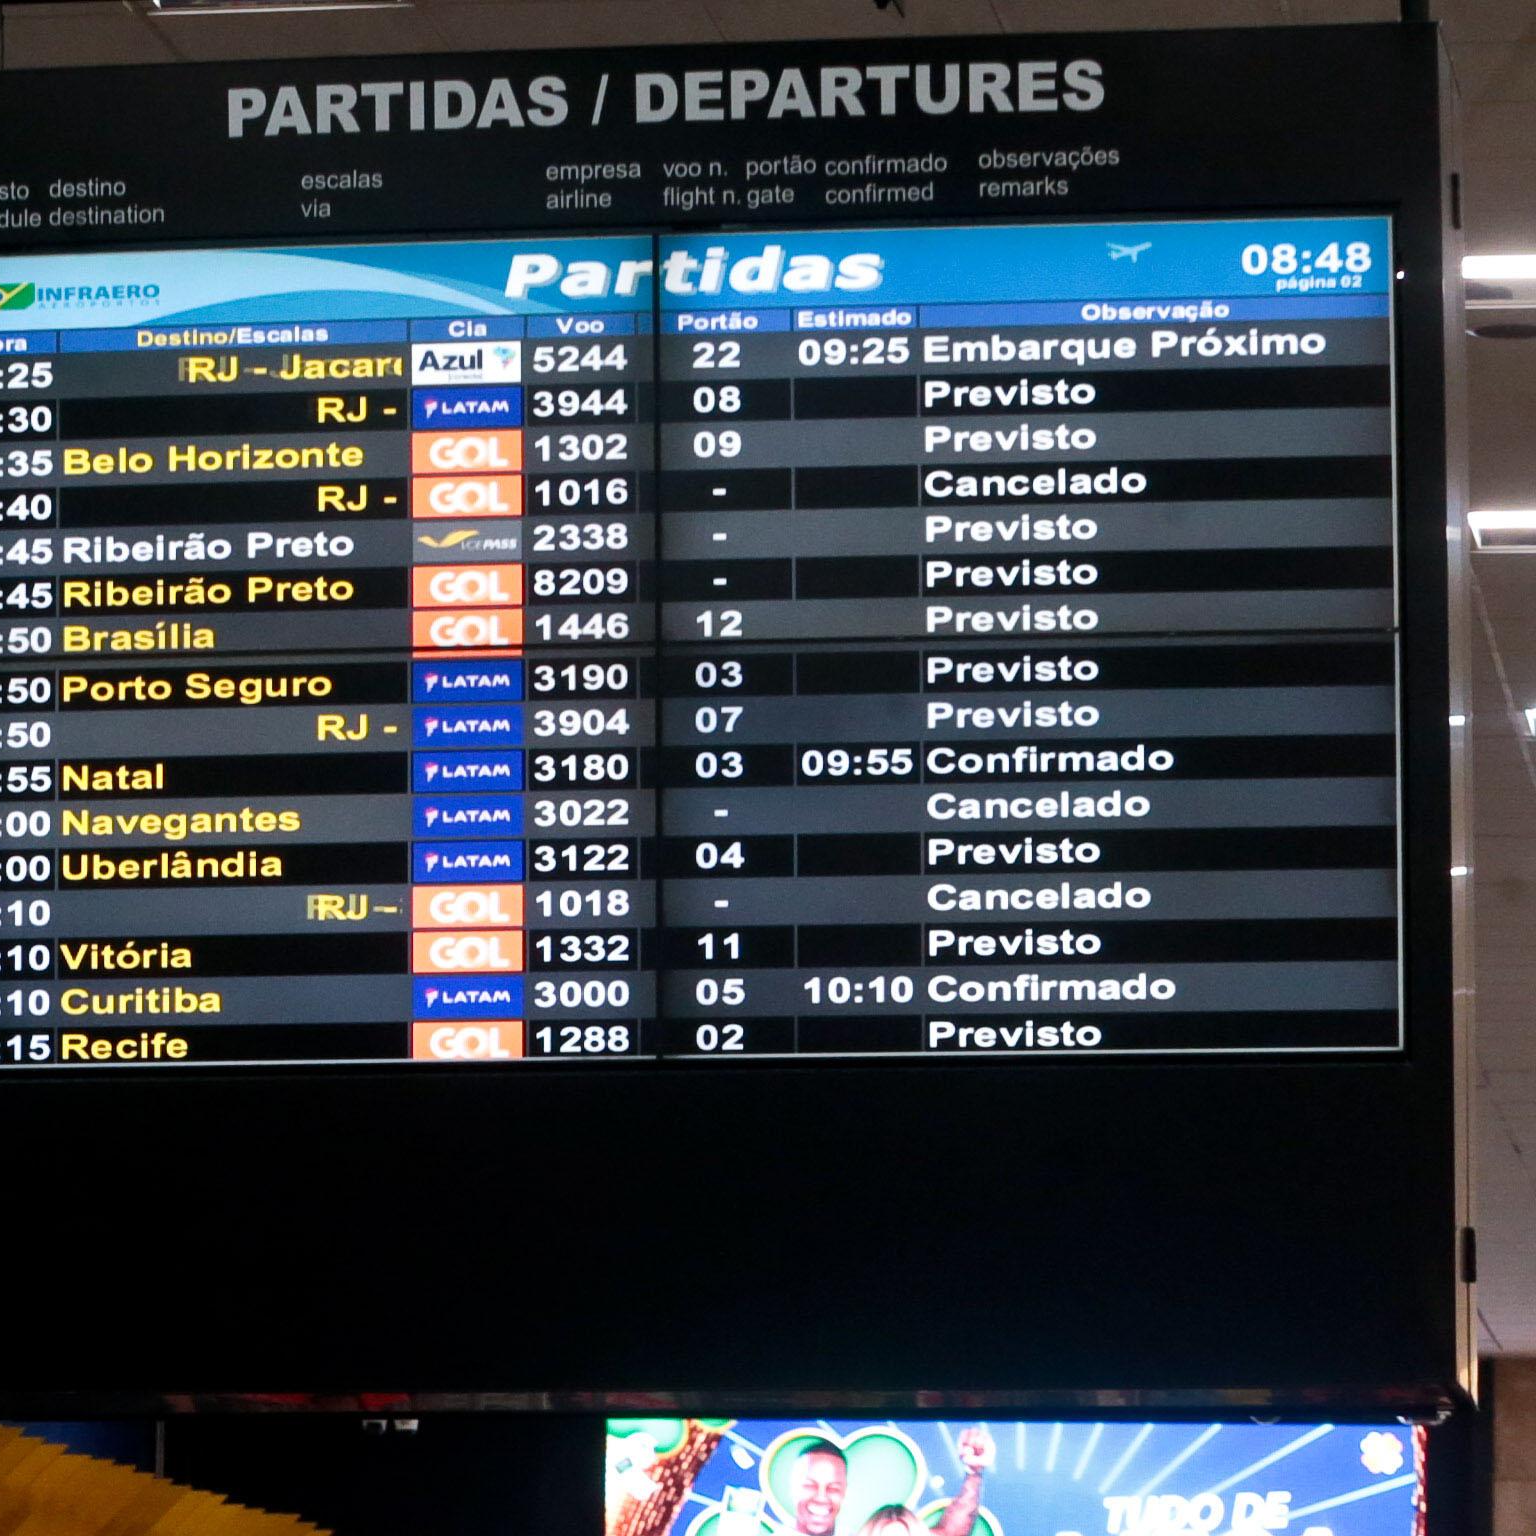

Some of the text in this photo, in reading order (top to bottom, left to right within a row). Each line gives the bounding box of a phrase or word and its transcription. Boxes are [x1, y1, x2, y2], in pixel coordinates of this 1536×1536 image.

[228, 76, 569, 138] PARTIDAS
[634, 59, 1105, 125] DEPARTURES
[545, 160, 642, 186] empresa
[663, 160, 703, 179] voo
[745, 154, 817, 182] portão
[824, 151, 948, 175] confirmado
[978, 144, 1121, 173] observações
[49, 176, 127, 200] destino
[301, 169, 384, 191] escalas
[505, 244, 885, 300] Partidas
[1241, 241, 1373, 278] 08:48
[36, 283, 161, 303] INFRAERO
[1275, 274, 1363, 293] página 02
[534, 344, 628, 373] 5244
[692, 341, 741, 369] 22
[797, 337, 910, 367] 09:25
[923, 324, 1326, 367] Embarque Próximo
[418, 348, 484, 375] Azul
[429, 436, 509, 468] GOL
[534, 433, 628, 461] 1302
[692, 430, 741, 458] 09
[925, 422, 1097, 454] Previsto
[63, 441, 364, 475] Belo Horizonte
[442, 763, 511, 779] LATAM
[534, 753, 629, 782] 3180
[695, 751, 744, 780] 03
[801, 748, 913, 778] 09:55
[927, 742, 1175, 775] Confirmado
[62, 762, 164, 792] Natal
[1103, 1490, 1292, 1534] TUDO DE
